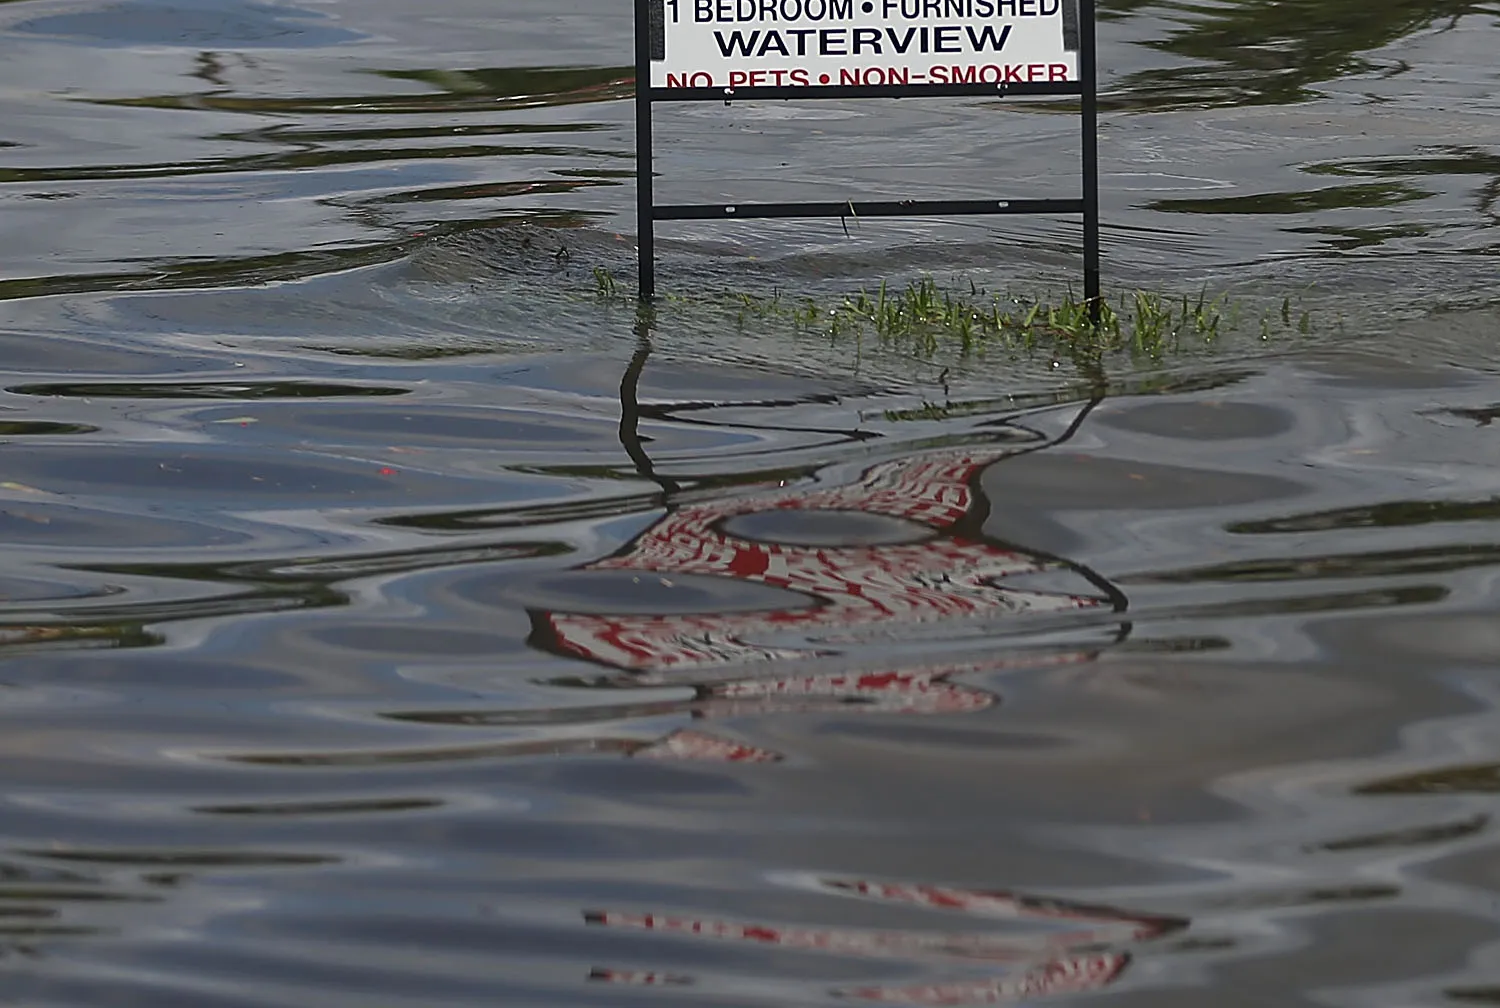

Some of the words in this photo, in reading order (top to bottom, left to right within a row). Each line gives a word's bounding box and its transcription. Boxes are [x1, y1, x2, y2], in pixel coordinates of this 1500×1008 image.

[713, 25, 1012, 56] WATERVIEW
[667, 72, 713, 88] NO
[729, 69, 809, 88] PETS
[839, 63, 1069, 86] NON-SMOKER
